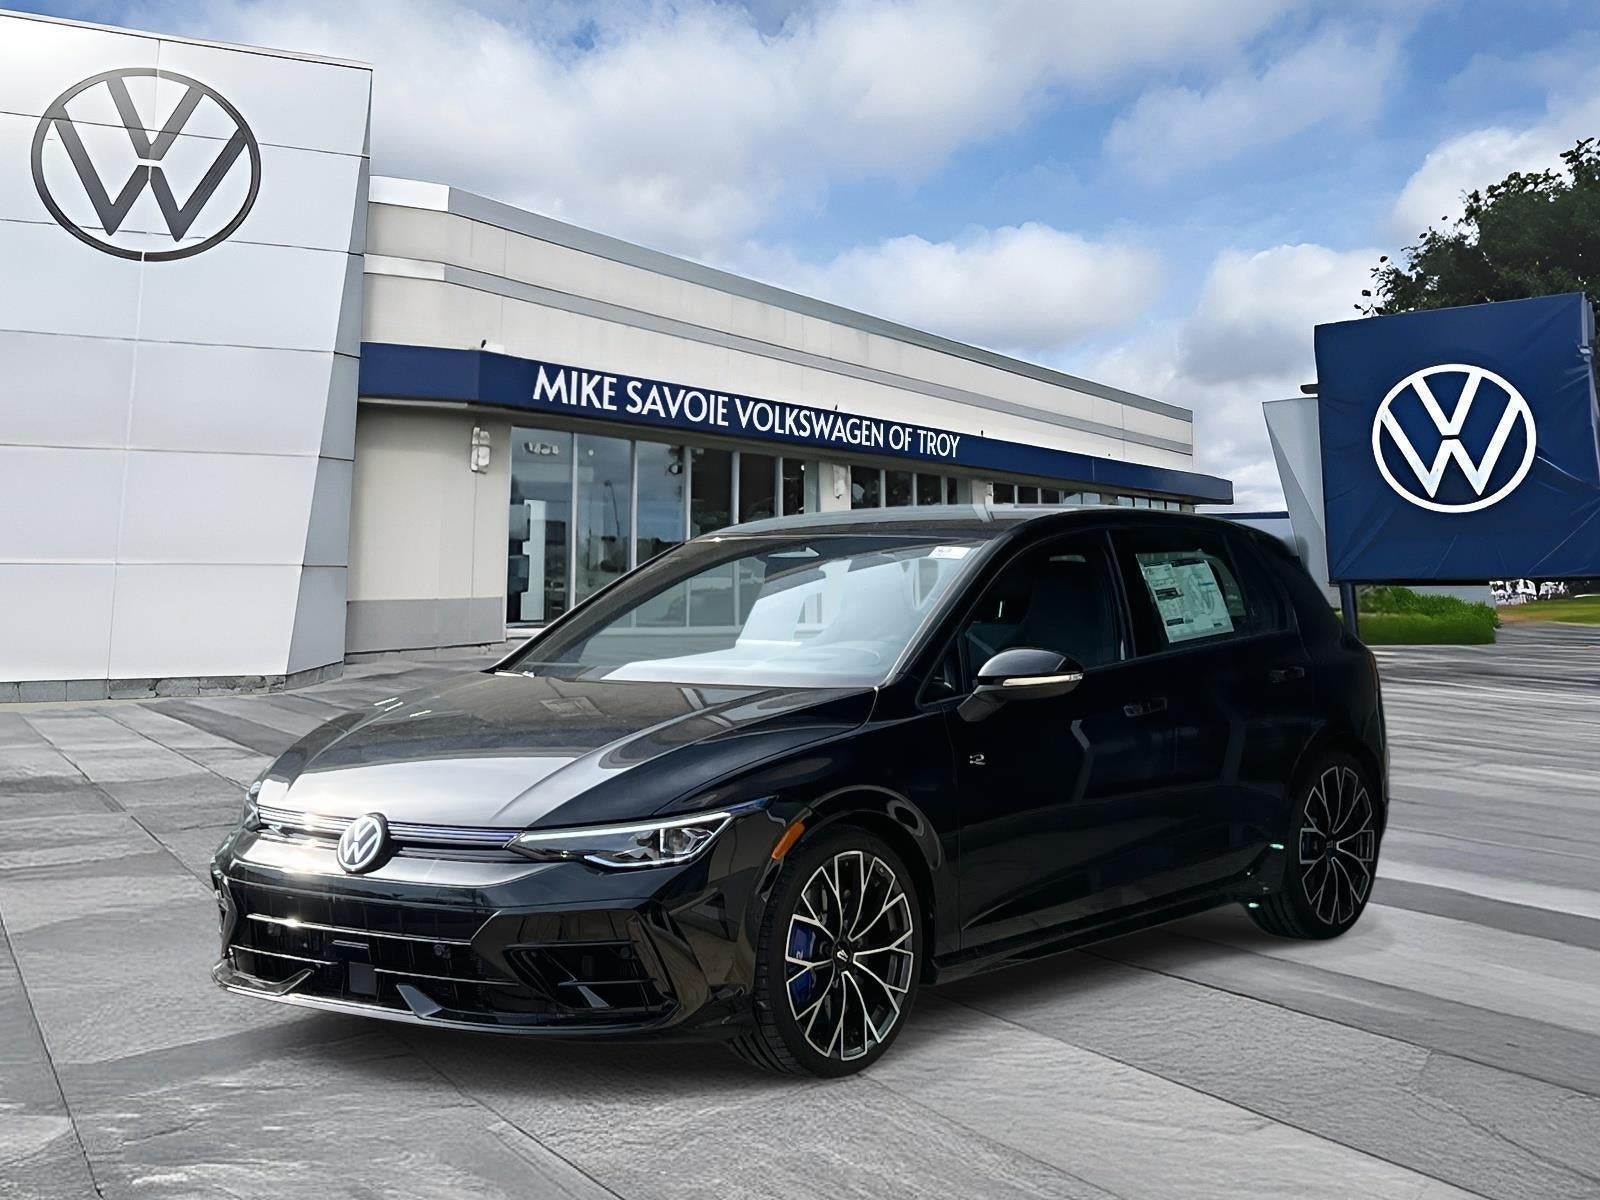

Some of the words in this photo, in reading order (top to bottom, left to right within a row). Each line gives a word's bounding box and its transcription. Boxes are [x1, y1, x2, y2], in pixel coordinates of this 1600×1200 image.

[31, 67, 261, 262] VW
[533, 365, 617, 411] MIKE
[625, 380, 729, 427] SAVOIE
[734, 398, 884, 448] VOLKSWAGEN
[888, 425, 912, 452] OF
[916, 429, 960, 458] TROY
[1372, 364, 1536, 513] VW
